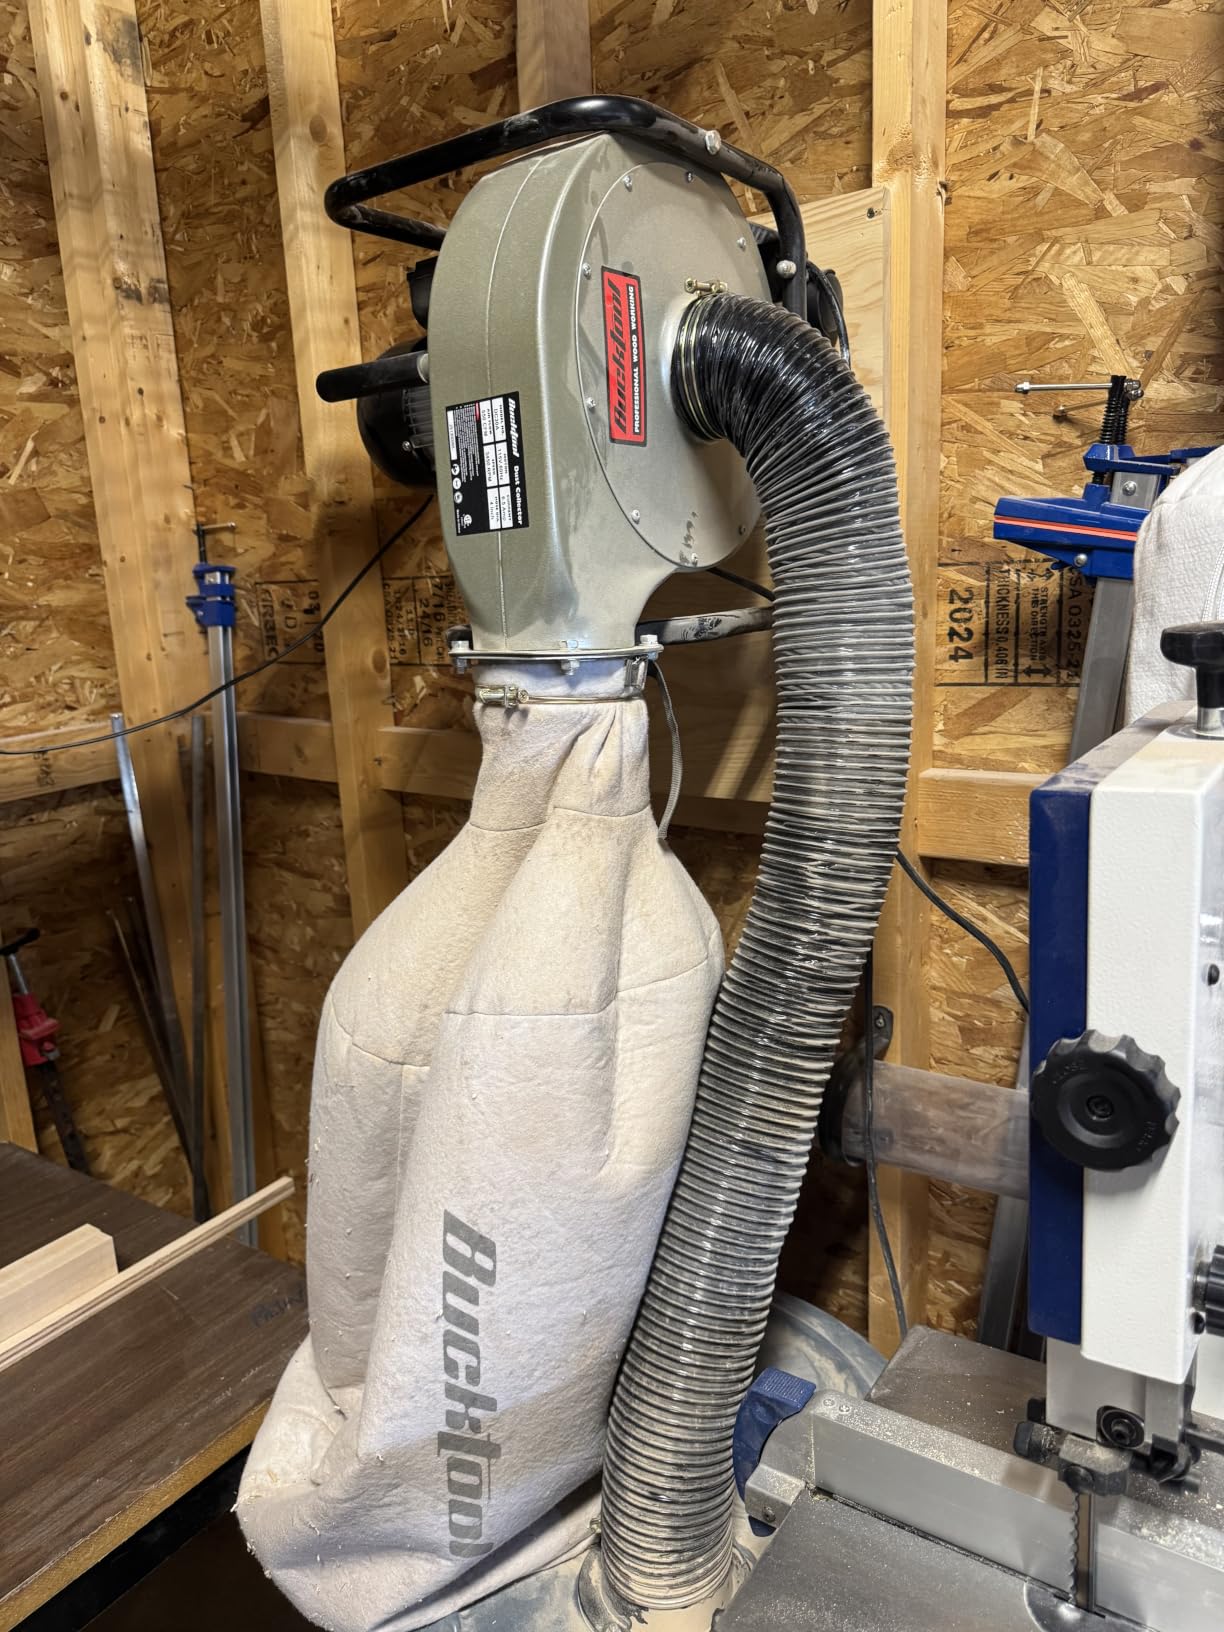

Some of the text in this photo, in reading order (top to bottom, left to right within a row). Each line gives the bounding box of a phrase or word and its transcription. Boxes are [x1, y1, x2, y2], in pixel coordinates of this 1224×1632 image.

[628, 286, 637, 330] WORKING
[608, 278, 627, 434] Bucktool
[508, 397, 520, 458] Bucktool
[515, 487, 523, 525] Collector
[420, 598, 433, 647] 24/16
[432, 583, 446, 622] 7/16
[947, 588, 974, 663] 2024
[995, 569, 1011, 634] THICKNESS
[1030, 588, 1039, 661] THIS DIRECTION
[1039, 587, 1048, 661] STRENGTH AXIS
[995, 636, 1009, 665] 0.406
[437, 1208, 502, 1562] Bucktool
